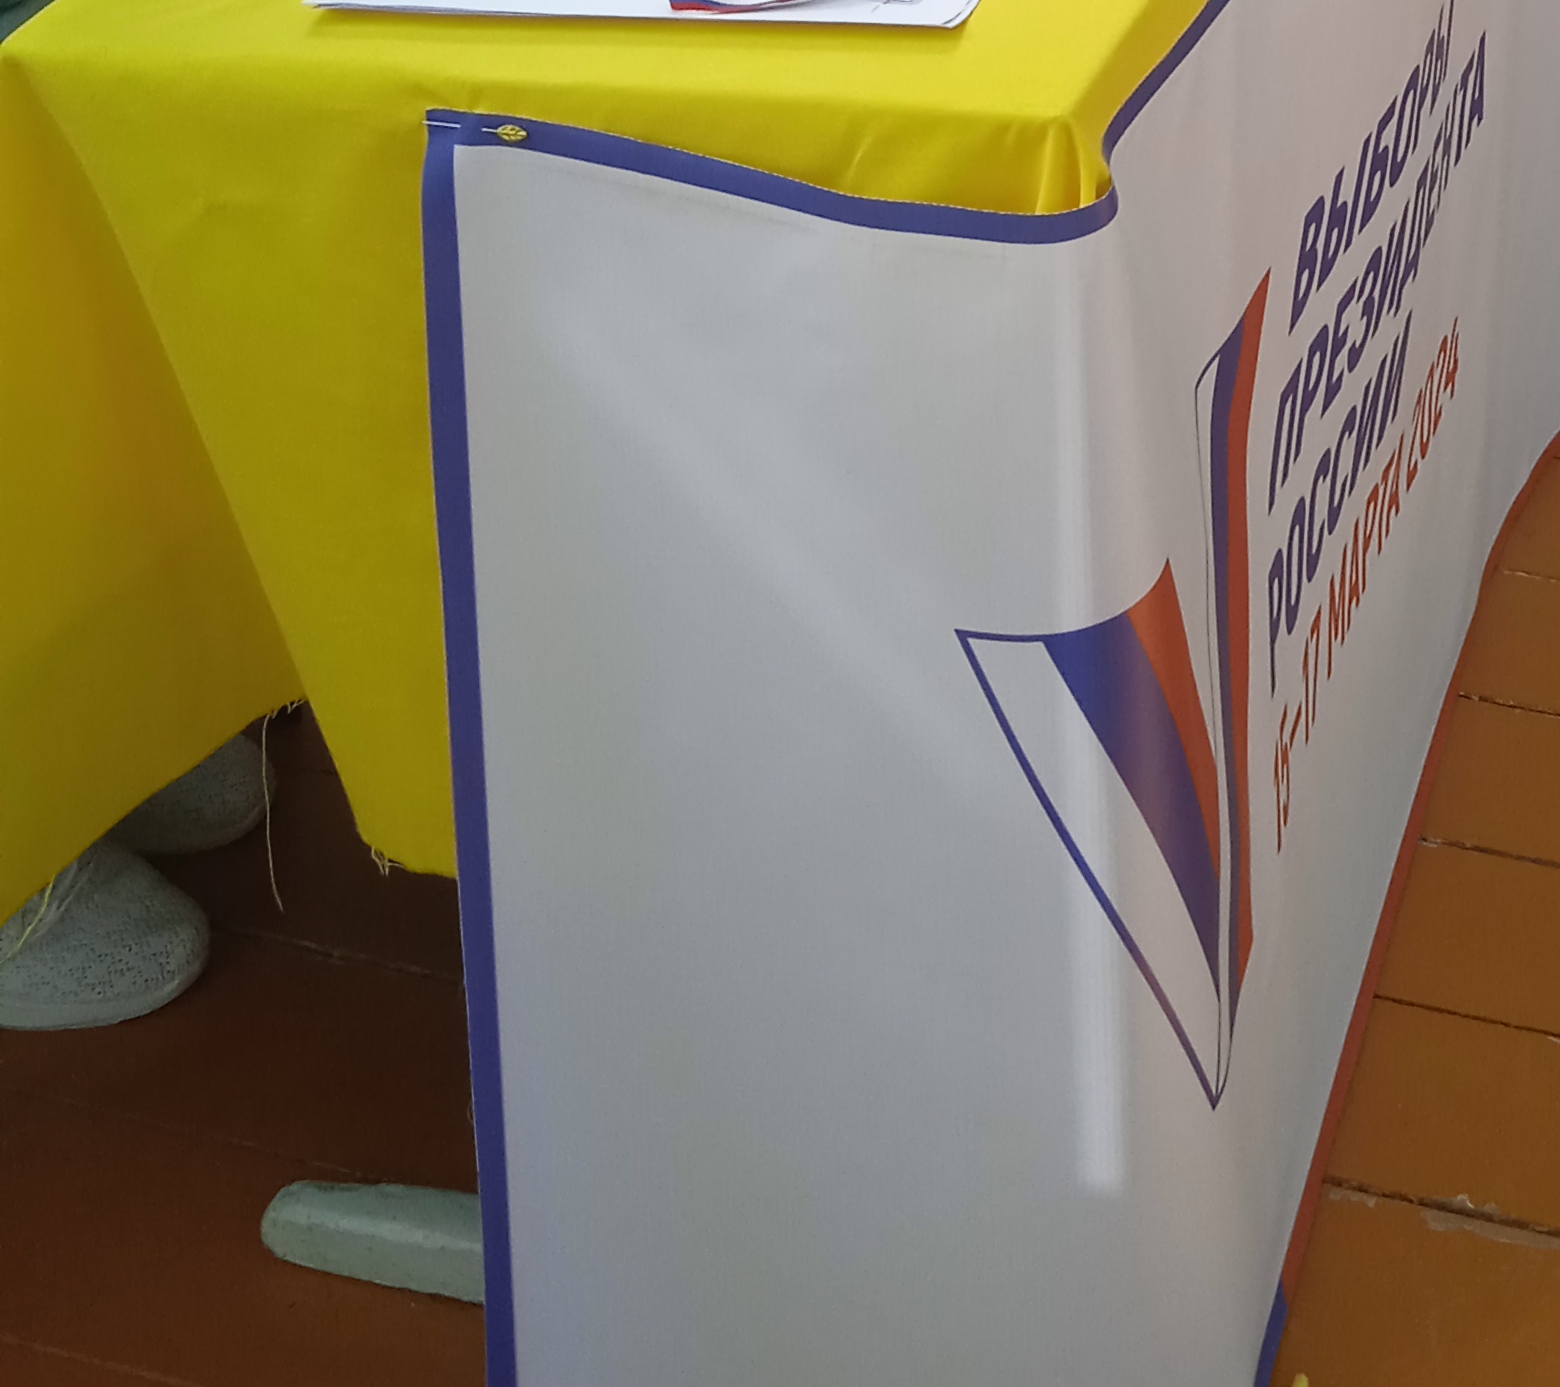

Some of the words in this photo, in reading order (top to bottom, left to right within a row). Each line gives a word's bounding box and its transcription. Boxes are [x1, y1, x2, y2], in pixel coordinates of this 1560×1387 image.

[1268, 30, 1487, 516] ПРЕЗИДЕНТА
[1268, 308, 1412, 700] РОССИИ
[1327, 433, 1404, 682] МАРТА
[1406, 315, 1460, 494] 2024
